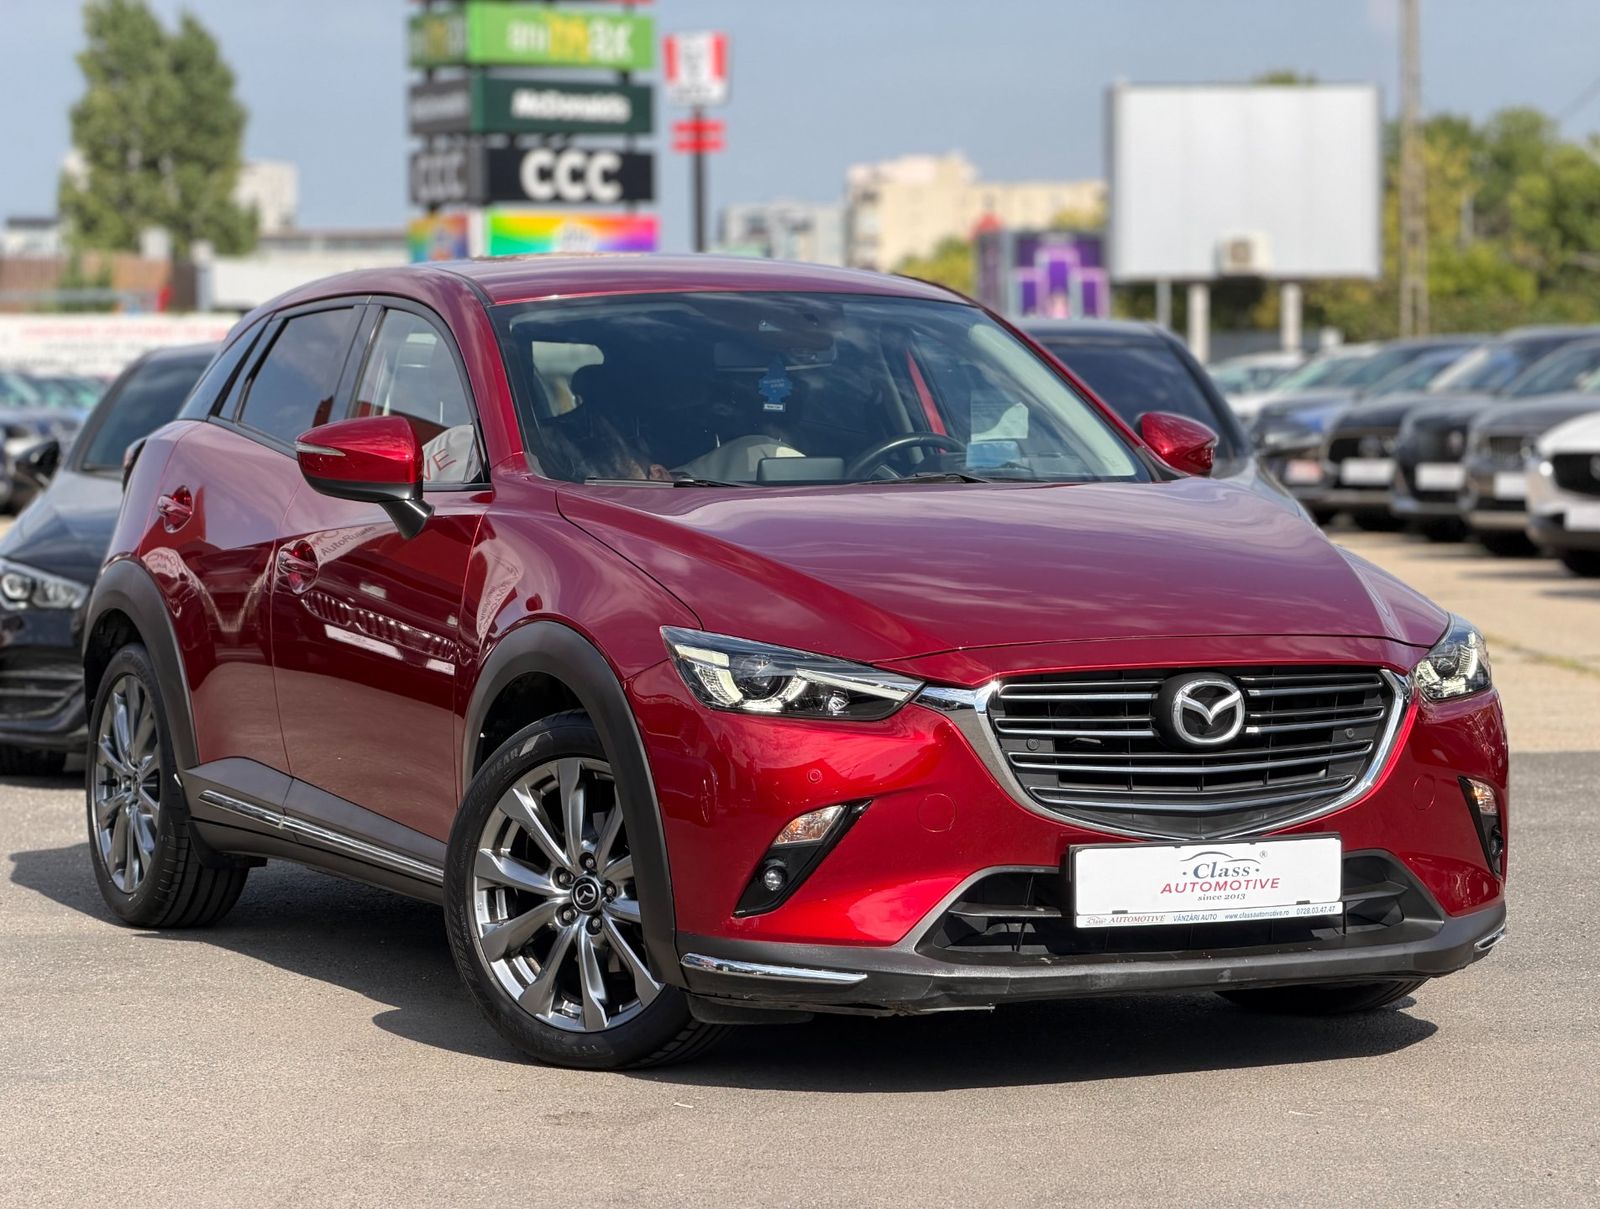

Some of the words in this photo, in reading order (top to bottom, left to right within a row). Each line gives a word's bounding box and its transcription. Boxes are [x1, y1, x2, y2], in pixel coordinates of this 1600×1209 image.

[520, 149, 623, 201] CCC
[1193, 862, 1251, 879] Class
[1160, 877, 1281, 895] AUTOMOTIVE
[1197, 894, 1222, 902] since
[1223, 893, 1246, 901] 2013
[1108, 915, 1166, 924] AUTOMOTIVE
[1224, 910, 1290, 920] www.classautomotive.ro
[1296, 906, 1336, 915] 0728.03.47.47
